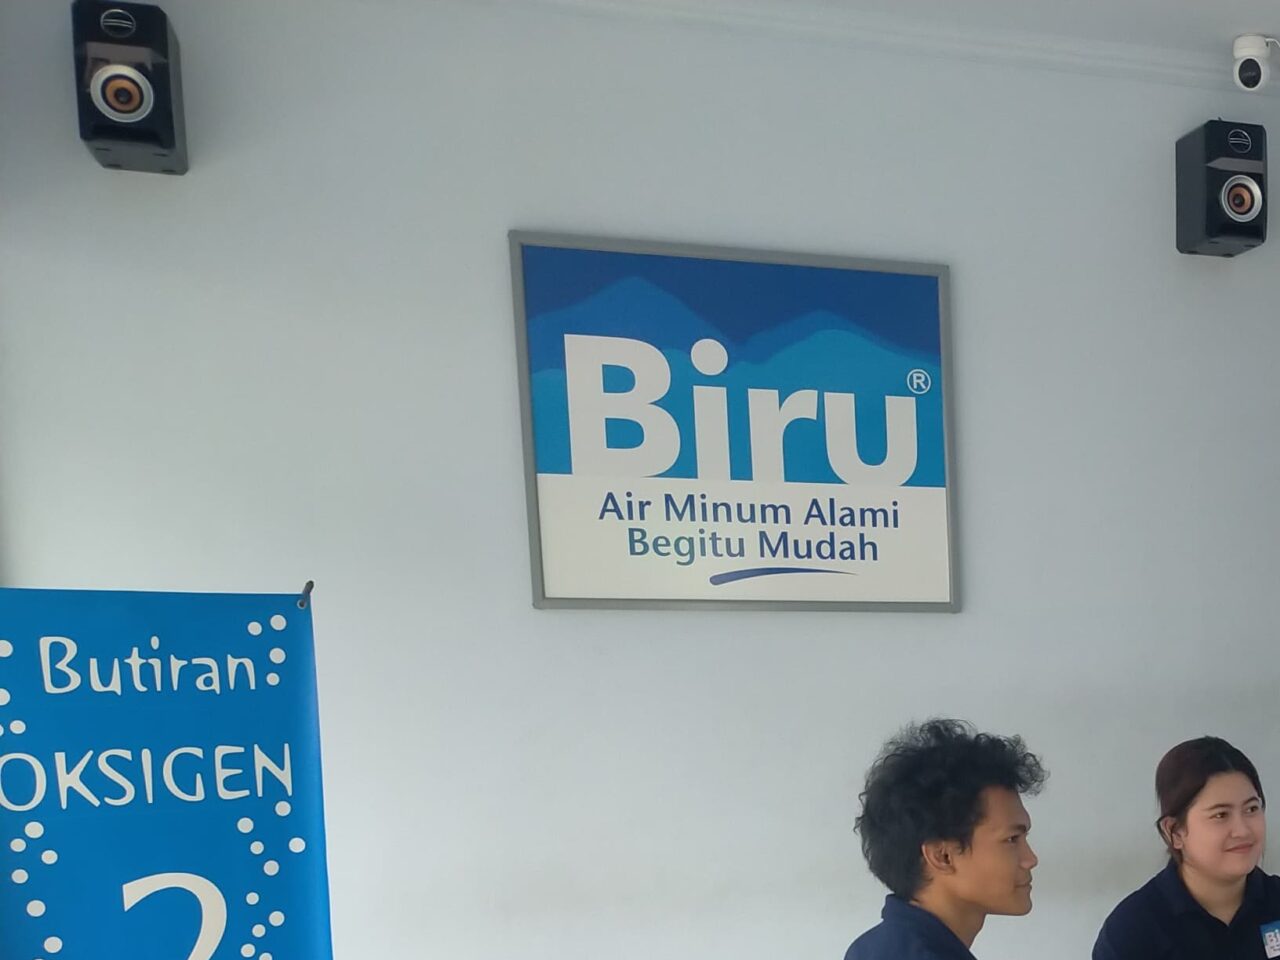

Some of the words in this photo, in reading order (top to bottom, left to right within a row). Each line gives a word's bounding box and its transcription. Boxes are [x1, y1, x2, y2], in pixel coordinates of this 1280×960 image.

[598, 492, 652, 521] Air
[664, 493, 791, 525] Minum
[803, 498, 899, 528] Alami
[628, 527, 746, 566] Begitu
[759, 531, 879, 562] Mudah
[39, 635, 257, 696] Butiran
[0, 743, 293, 812] OKSIGEN
